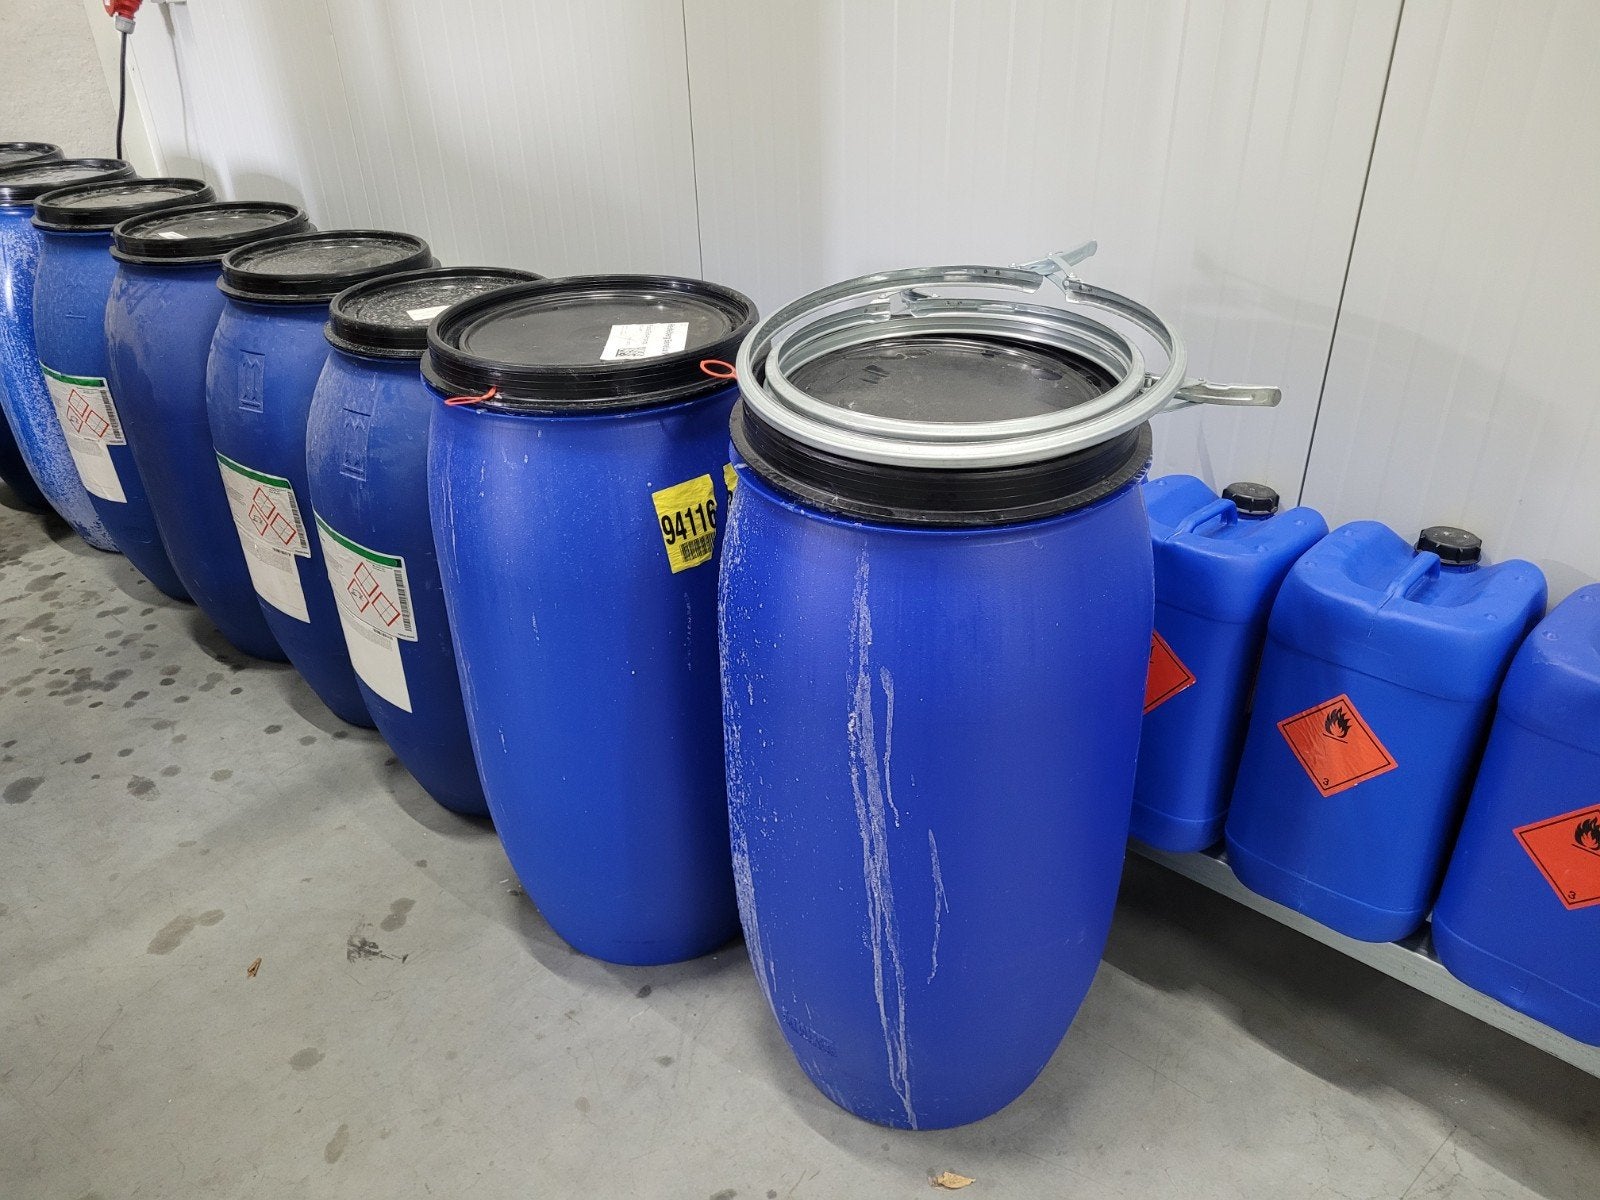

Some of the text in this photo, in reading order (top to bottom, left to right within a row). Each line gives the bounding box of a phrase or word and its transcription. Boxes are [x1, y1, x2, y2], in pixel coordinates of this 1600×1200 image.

[661, 499, 716, 545] 94116
[1322, 778, 1330, 786] 3
[1568, 891, 1576, 899] 3
